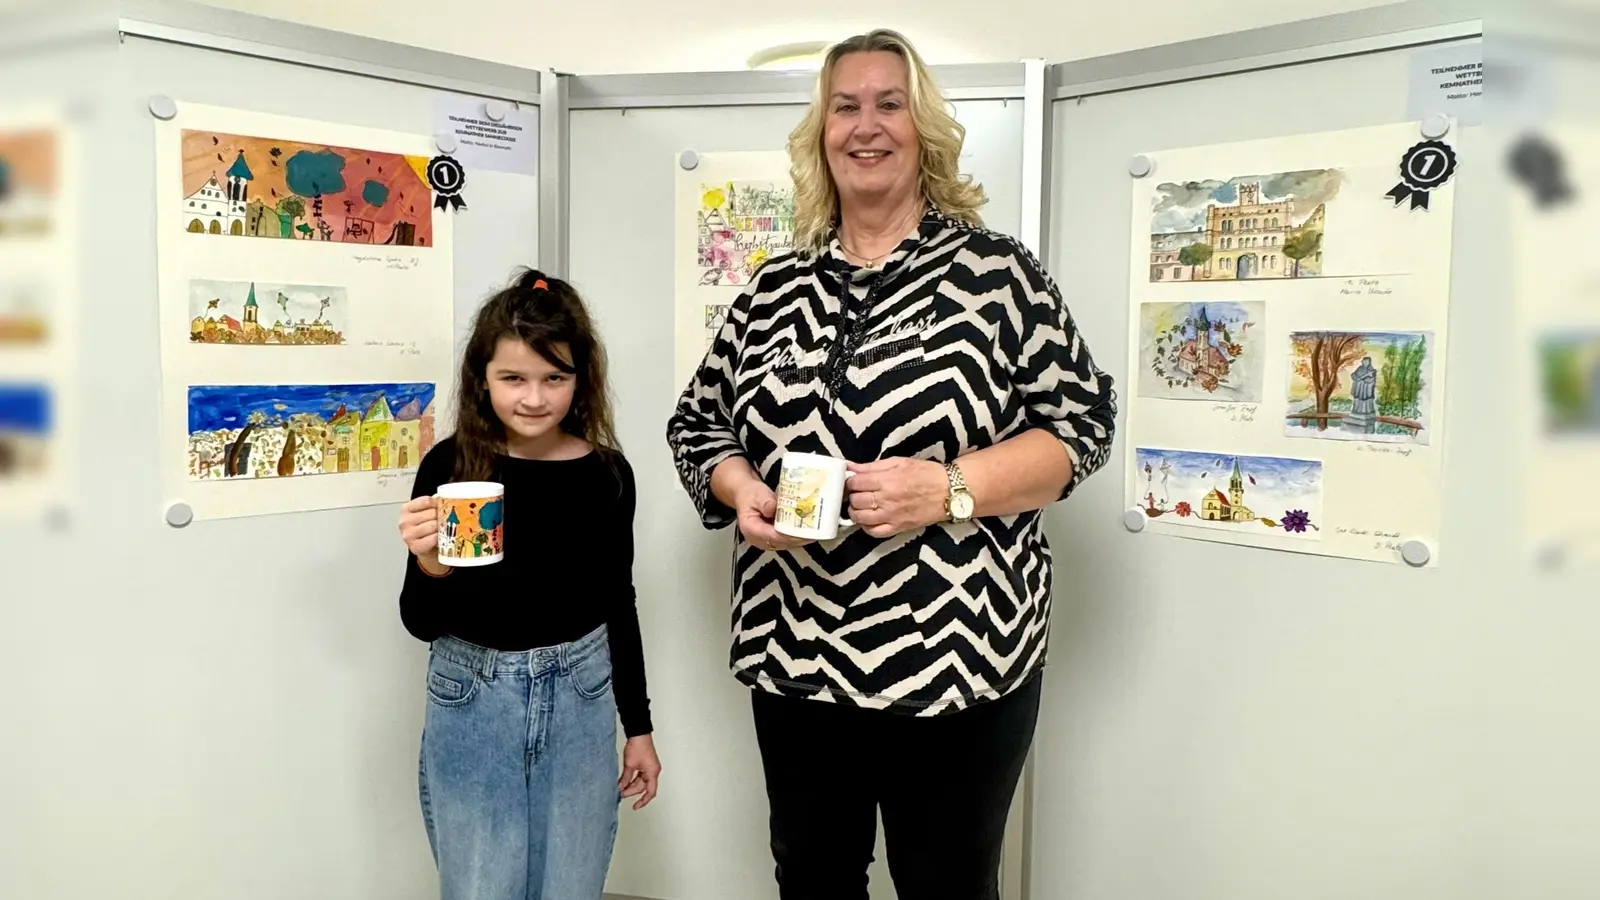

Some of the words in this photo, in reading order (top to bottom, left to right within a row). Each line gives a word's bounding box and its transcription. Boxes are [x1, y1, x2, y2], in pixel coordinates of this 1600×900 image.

[1431, 63, 1476, 74] TEILNEHMER
[439, 165, 450, 185] 1
[1419, 153, 1437, 177] 1
